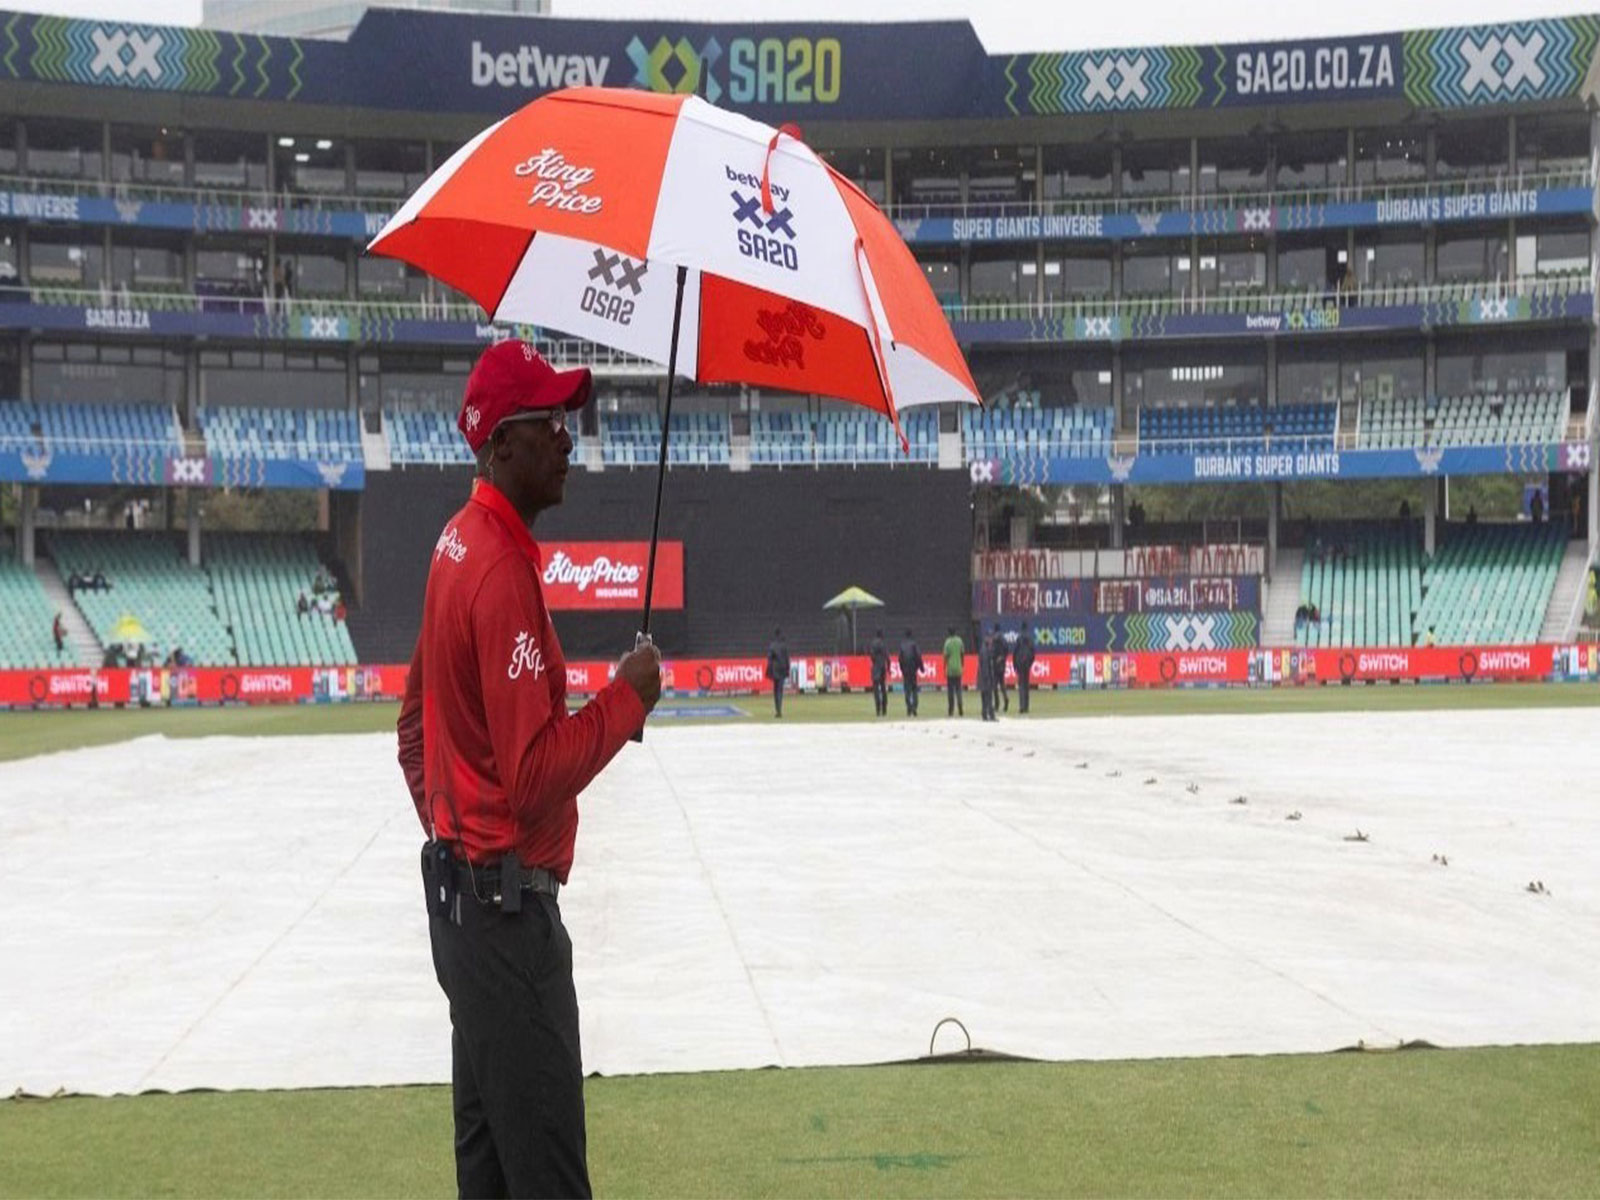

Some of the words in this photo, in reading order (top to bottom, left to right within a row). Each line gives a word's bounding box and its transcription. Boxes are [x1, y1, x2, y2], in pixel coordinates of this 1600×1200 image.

[471, 41, 610, 88] betway
[730, 38, 841, 103] SA20
[1236, 45, 1394, 94] SA20.CO.ZA
[514, 147, 595, 184] King
[527, 181, 603, 214] Price
[1377, 199, 1440, 222] DURBAN'S
[1444, 196, 1486, 219] SUPER
[1489, 191, 1538, 216] GIANTS
[952, 216, 992, 239] SUPER
[996, 217, 1040, 237] GIANTS
[1043, 215, 1103, 237] UNIVERSE
[737, 228, 799, 271] SA20
[86, 307, 150, 328] SA20.CO.ZA
[1246, 314, 1281, 331] betway
[1310, 309, 1339, 328] SA20
[1194, 454, 1251, 477] DURBAN'S
[1255, 454, 1295, 474] SUPER
[1296, 453, 1339, 473] GIANTS
[595, 587, 639, 599] INSURANCE
[1057, 627, 1086, 645] SA20
[1179, 656, 1227, 673] SWITCH
[1359, 654, 1408, 671] SWITCH
[1479, 652, 1530, 670] SWITCH
[241, 674, 292, 692] SWITCH
[715, 665, 763, 683] SWITCH
